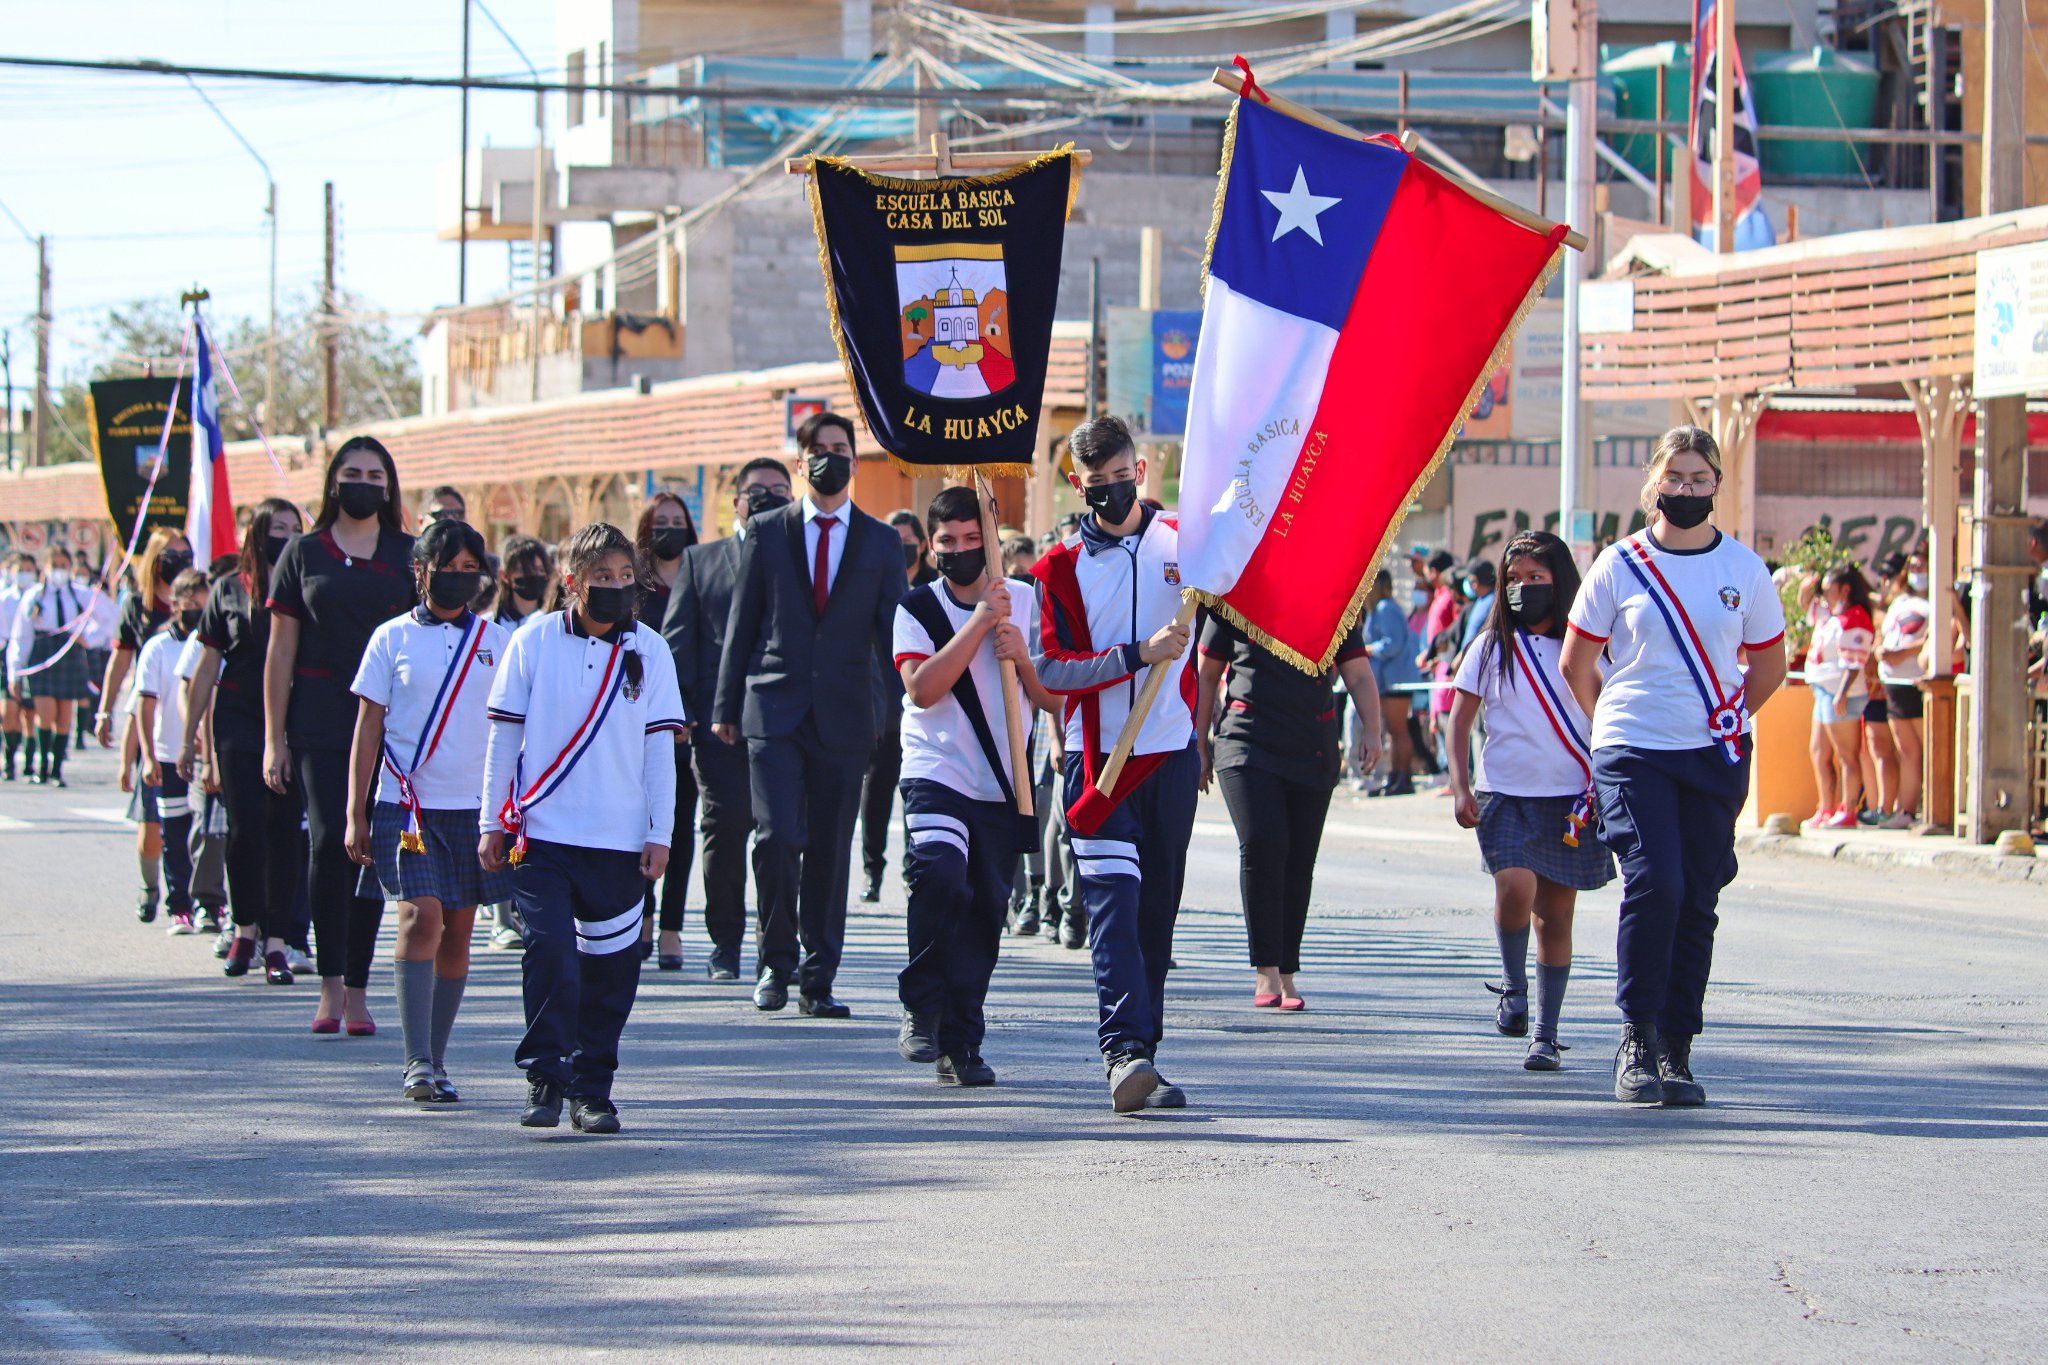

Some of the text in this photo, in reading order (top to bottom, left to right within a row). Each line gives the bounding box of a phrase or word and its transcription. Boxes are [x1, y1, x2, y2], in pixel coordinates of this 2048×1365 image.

[875, 189, 1015, 211] ESCUELA BASICA
[886, 208, 1007, 230] CASA DEL SOL
[904, 404, 1029, 440] LA HUAYCA
[1234, 418, 1301, 528] ESCUELA BASICA
[1273, 430, 1328, 538] LA HUAYCA
